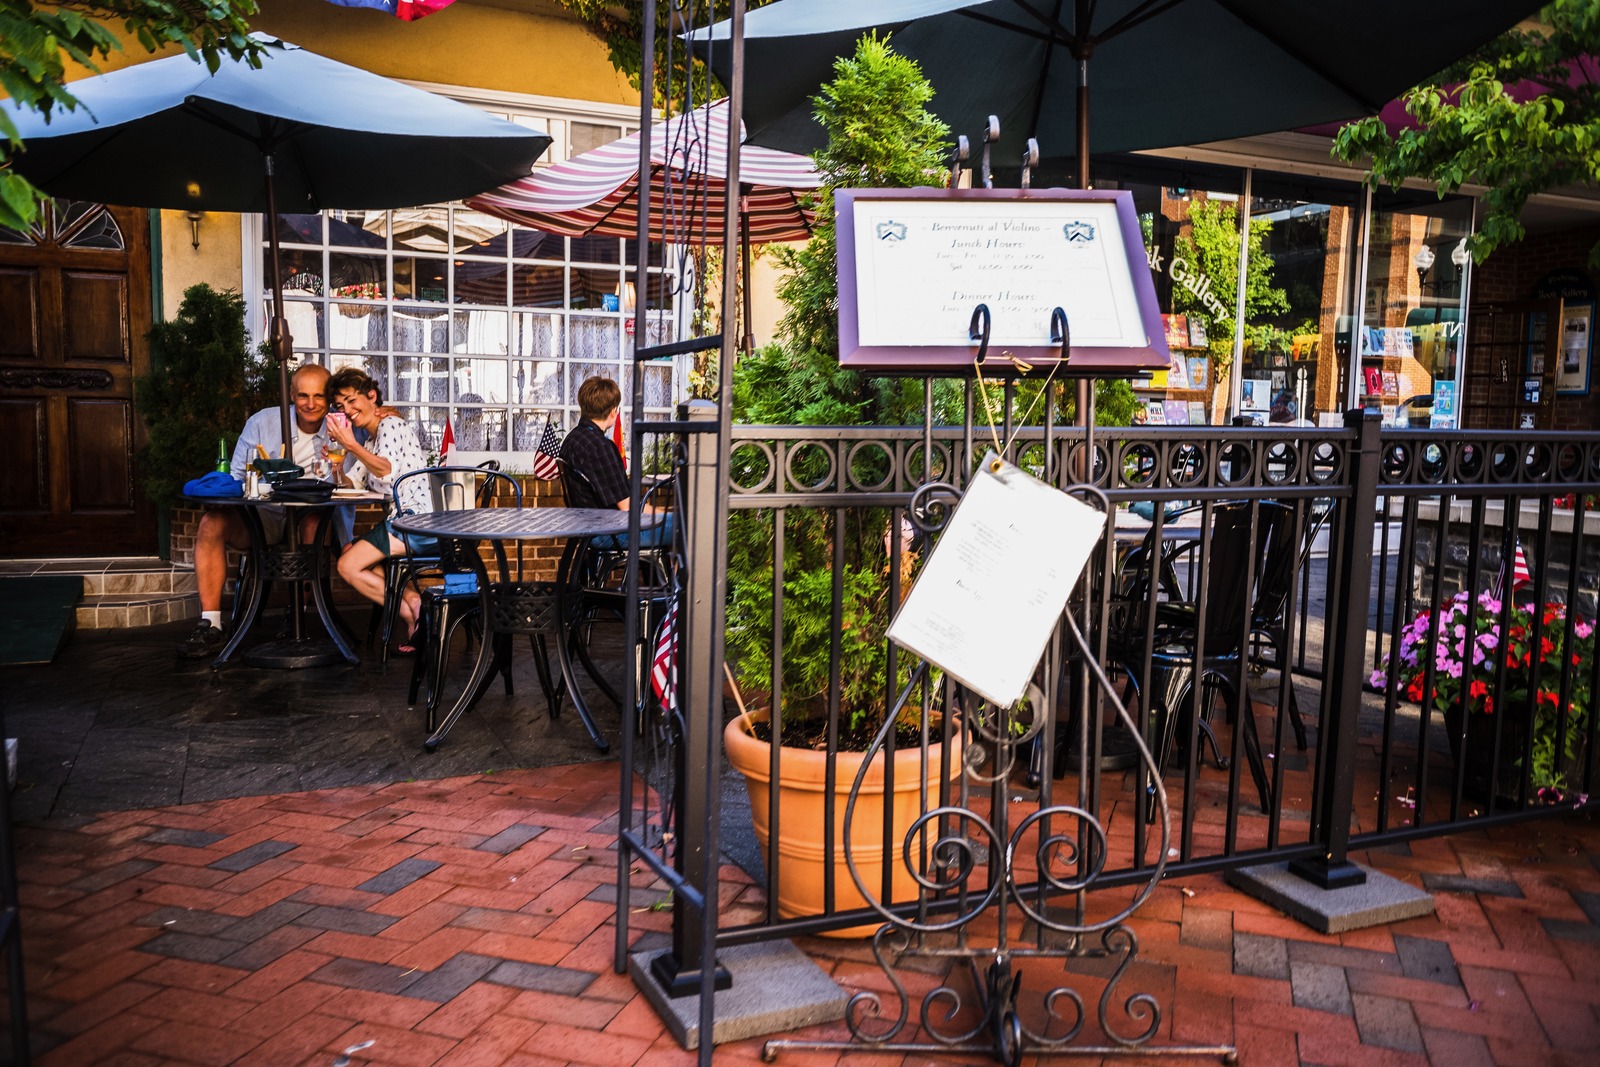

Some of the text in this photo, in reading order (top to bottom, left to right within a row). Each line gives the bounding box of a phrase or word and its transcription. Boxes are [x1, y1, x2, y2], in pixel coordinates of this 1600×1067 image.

[931, 219, 1041, 232] Benvenuti al Violino
[952, 290, 994, 301] Dinner
[1169, 257, 1230, 324] Gallery
[1500, 359, 1509, 384] OPEN
